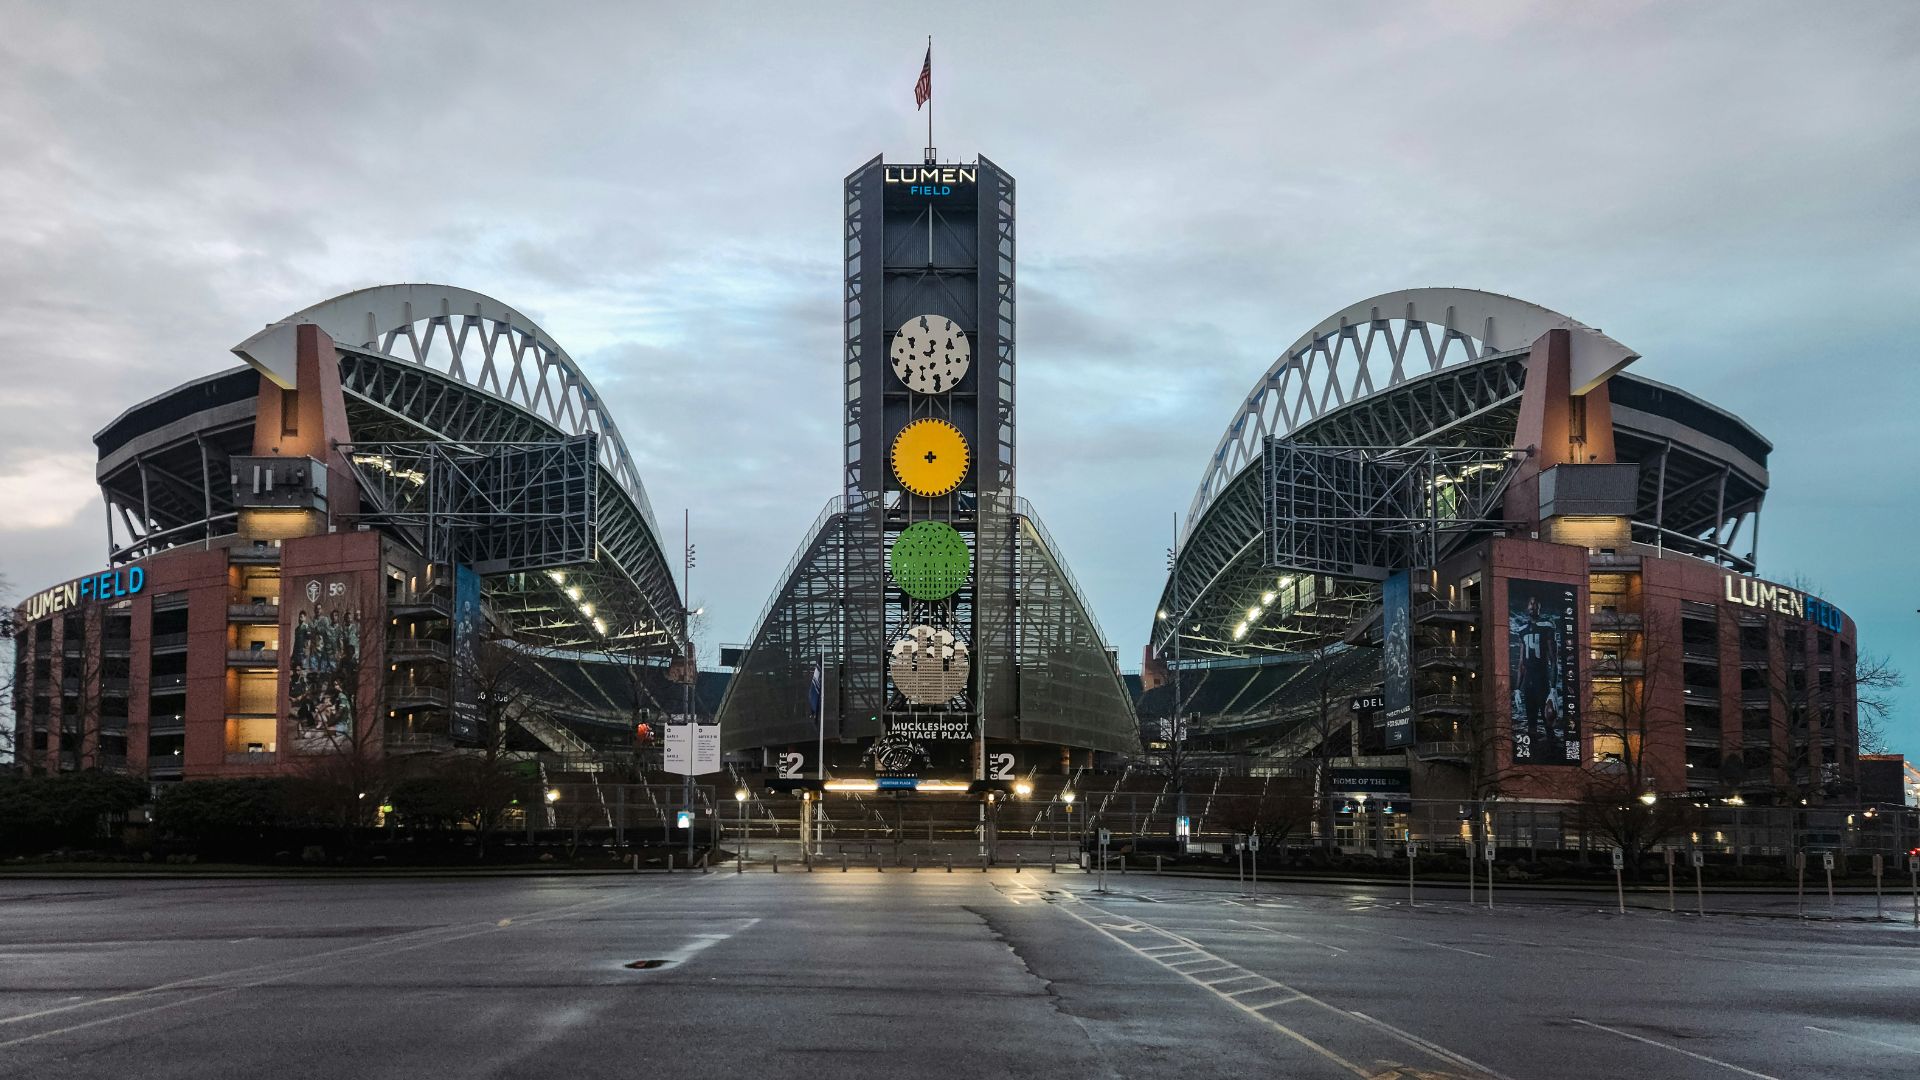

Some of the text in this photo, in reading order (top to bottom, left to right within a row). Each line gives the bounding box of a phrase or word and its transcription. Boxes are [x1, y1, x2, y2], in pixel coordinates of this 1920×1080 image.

[885, 168, 976, 183] LUMEN
[910, 186, 951, 196] FIELD
[26, 565, 145, 622] LUMEN FIELD
[1725, 575, 1842, 633] LUMEN FIELD
[891, 722, 969, 731] MUCKLESHOOT
[941, 731, 973, 740] PLAZA
[1515, 734, 1531, 746] 20
[1516, 745, 1531, 759] 24
[779, 751, 804, 779] GATE 2
[990, 752, 1016, 781] GATE 2
[1333, 777, 1357, 785] HOME
[1369, 778, 1386, 786] THE
